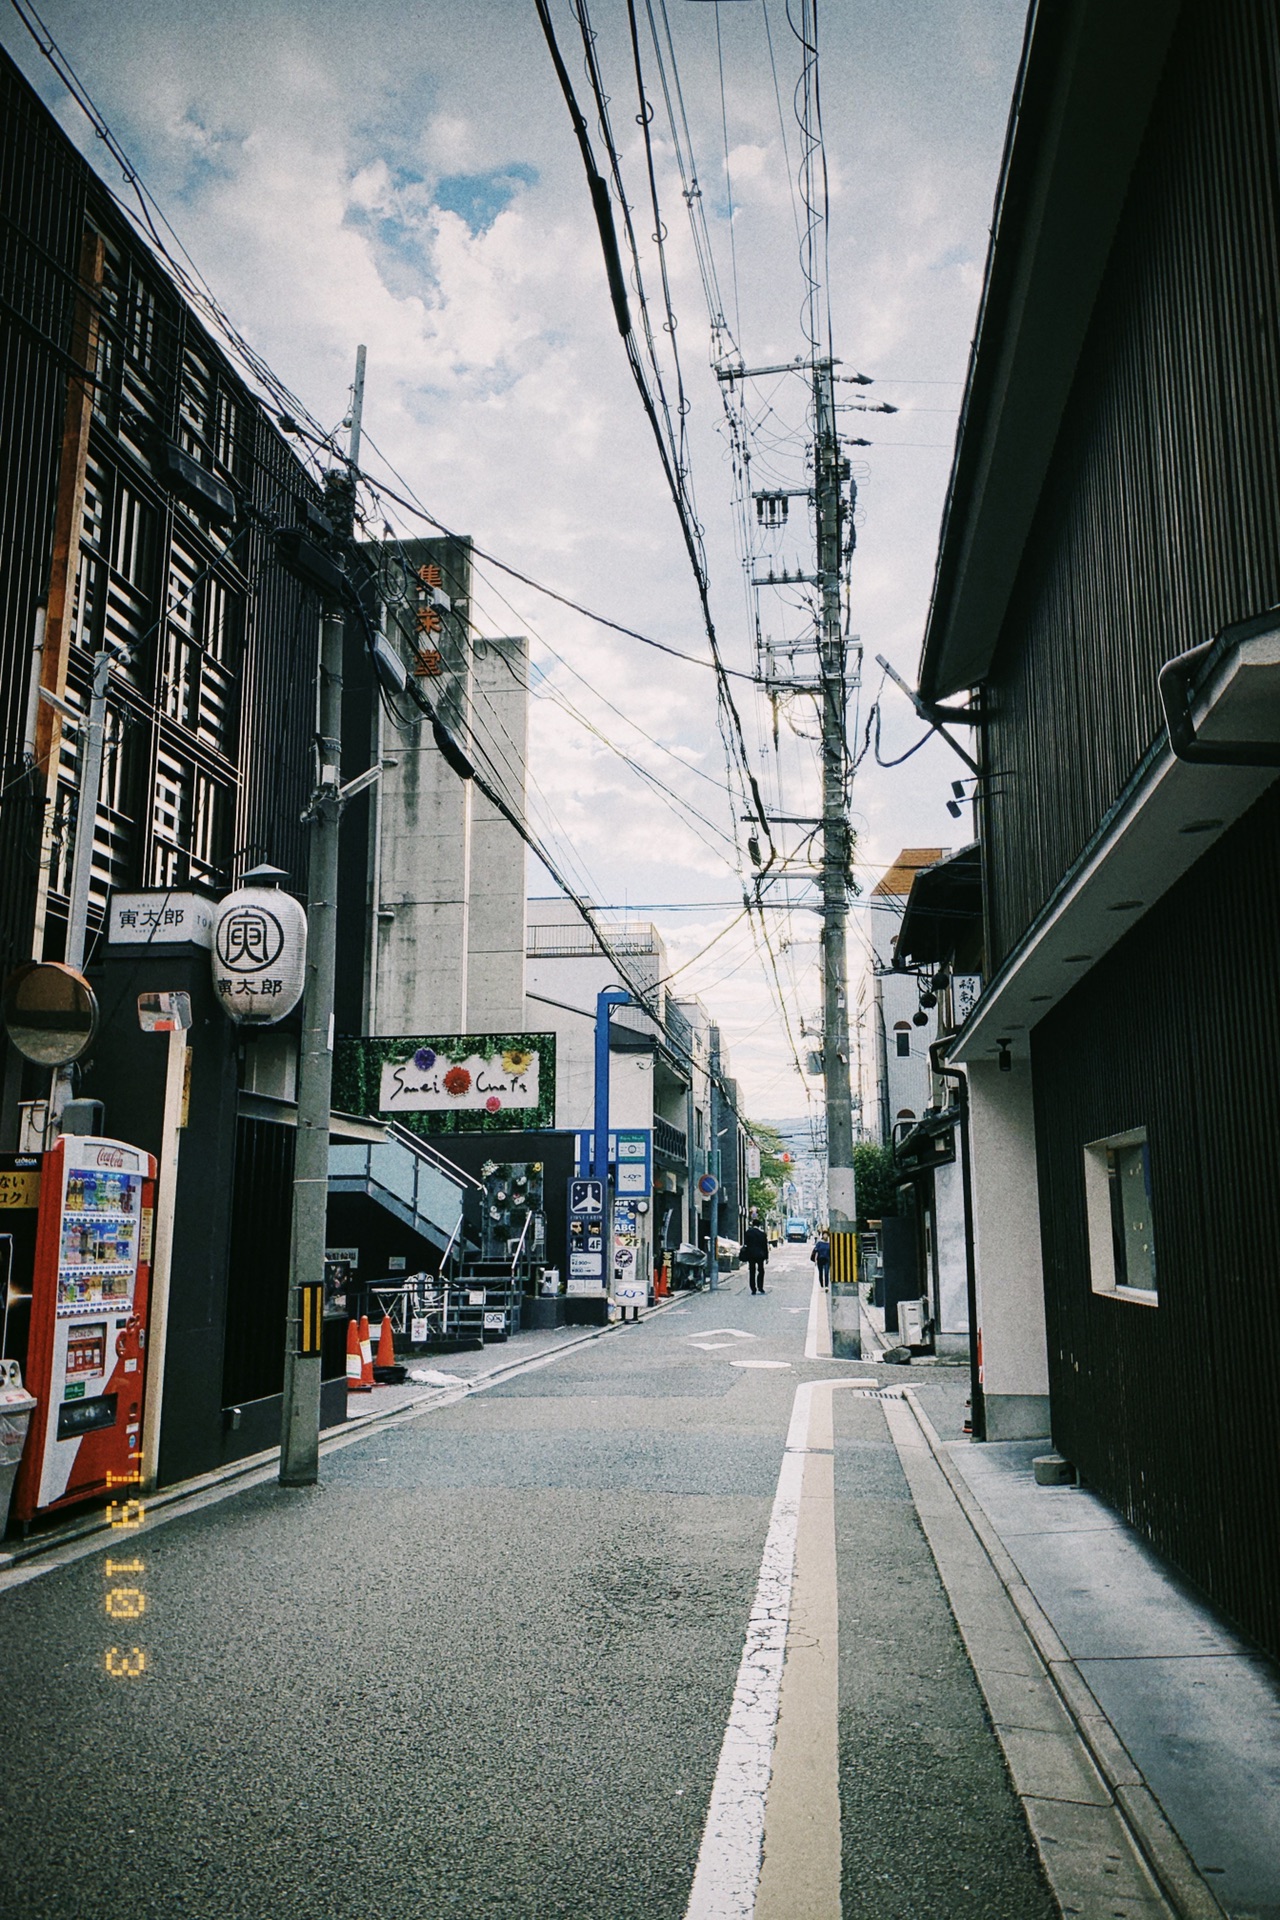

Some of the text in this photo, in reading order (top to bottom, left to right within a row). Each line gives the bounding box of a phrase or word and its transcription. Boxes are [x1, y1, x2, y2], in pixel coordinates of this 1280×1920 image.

[119, 908, 185, 928] 寅太郎
[218, 978, 283, 996] 寅太郎
[589, 1240, 601, 1249] 4F
[625, 1239, 639, 1247] 2F
